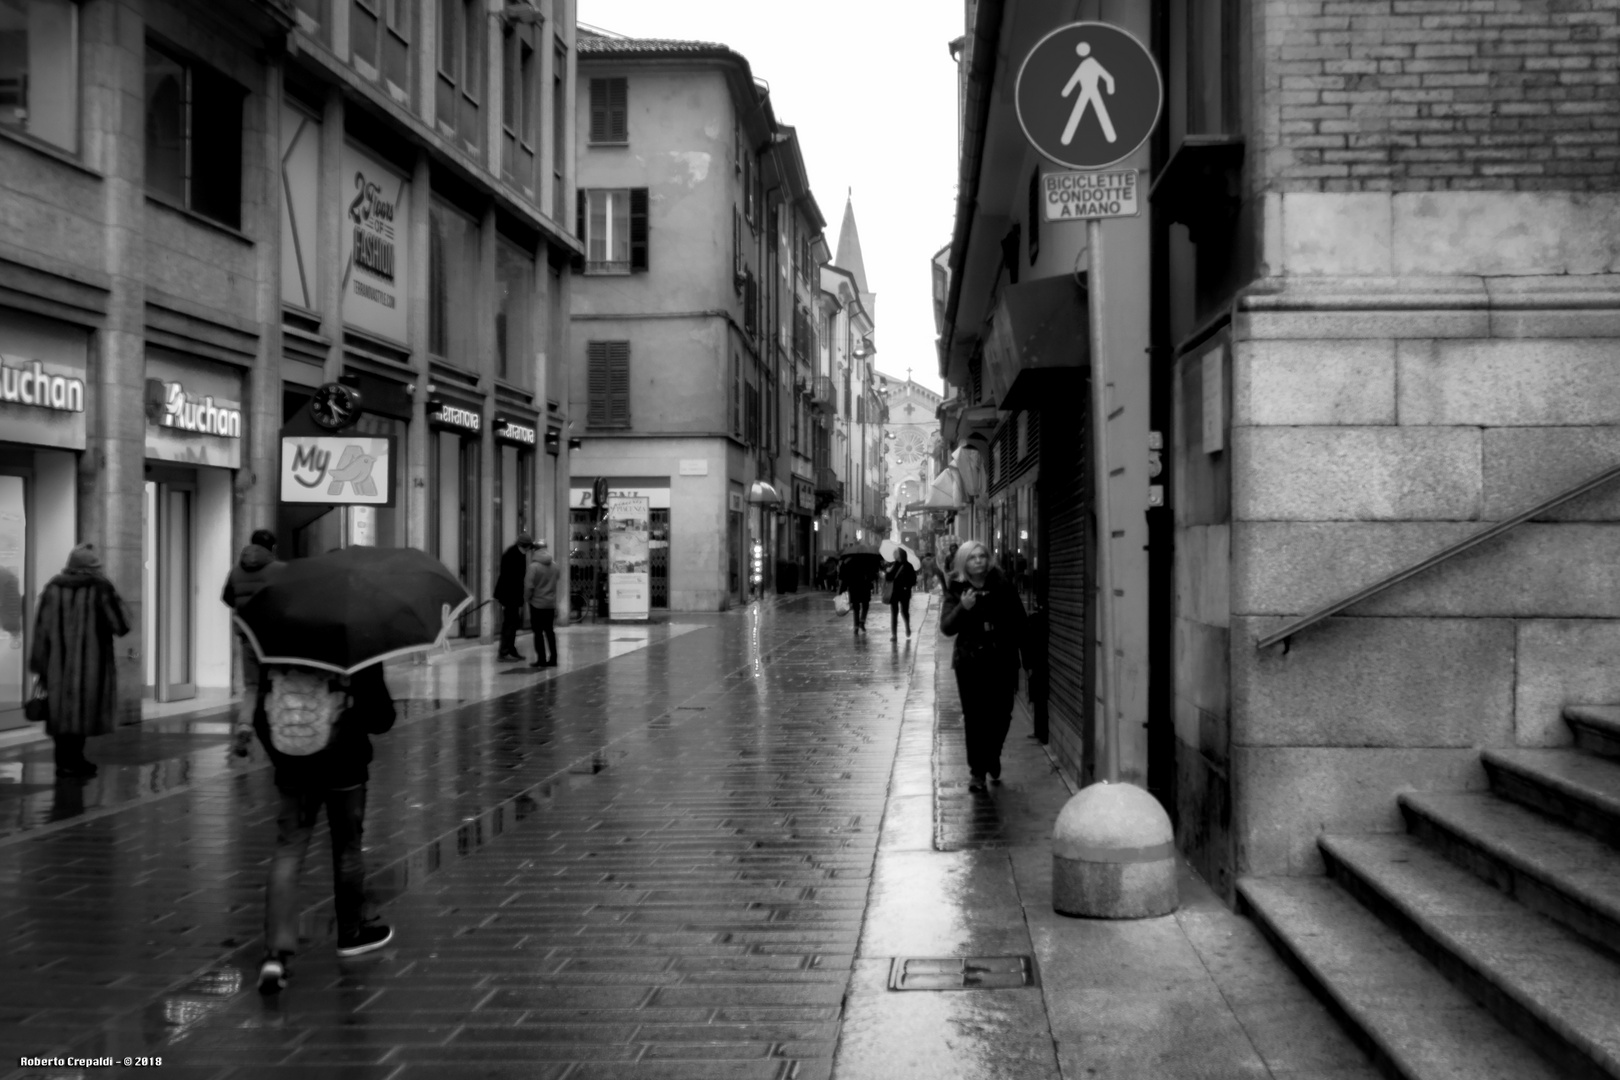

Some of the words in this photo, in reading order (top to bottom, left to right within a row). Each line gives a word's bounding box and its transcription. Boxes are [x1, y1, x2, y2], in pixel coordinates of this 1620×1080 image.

[1047, 173, 1134, 191] BICICLETTE
[1048, 187, 1132, 204] CONDOTTE
[348, 171, 365, 225] 2
[362, 182, 394, 222] Floors
[1061, 204, 1071, 217] A
[1075, 201, 1121, 216] MANO
[374, 219, 385, 233] OF
[353, 226, 395, 280] FASHION
[0, 357, 84, 412] uchan
[292, 445, 331, 488] My
